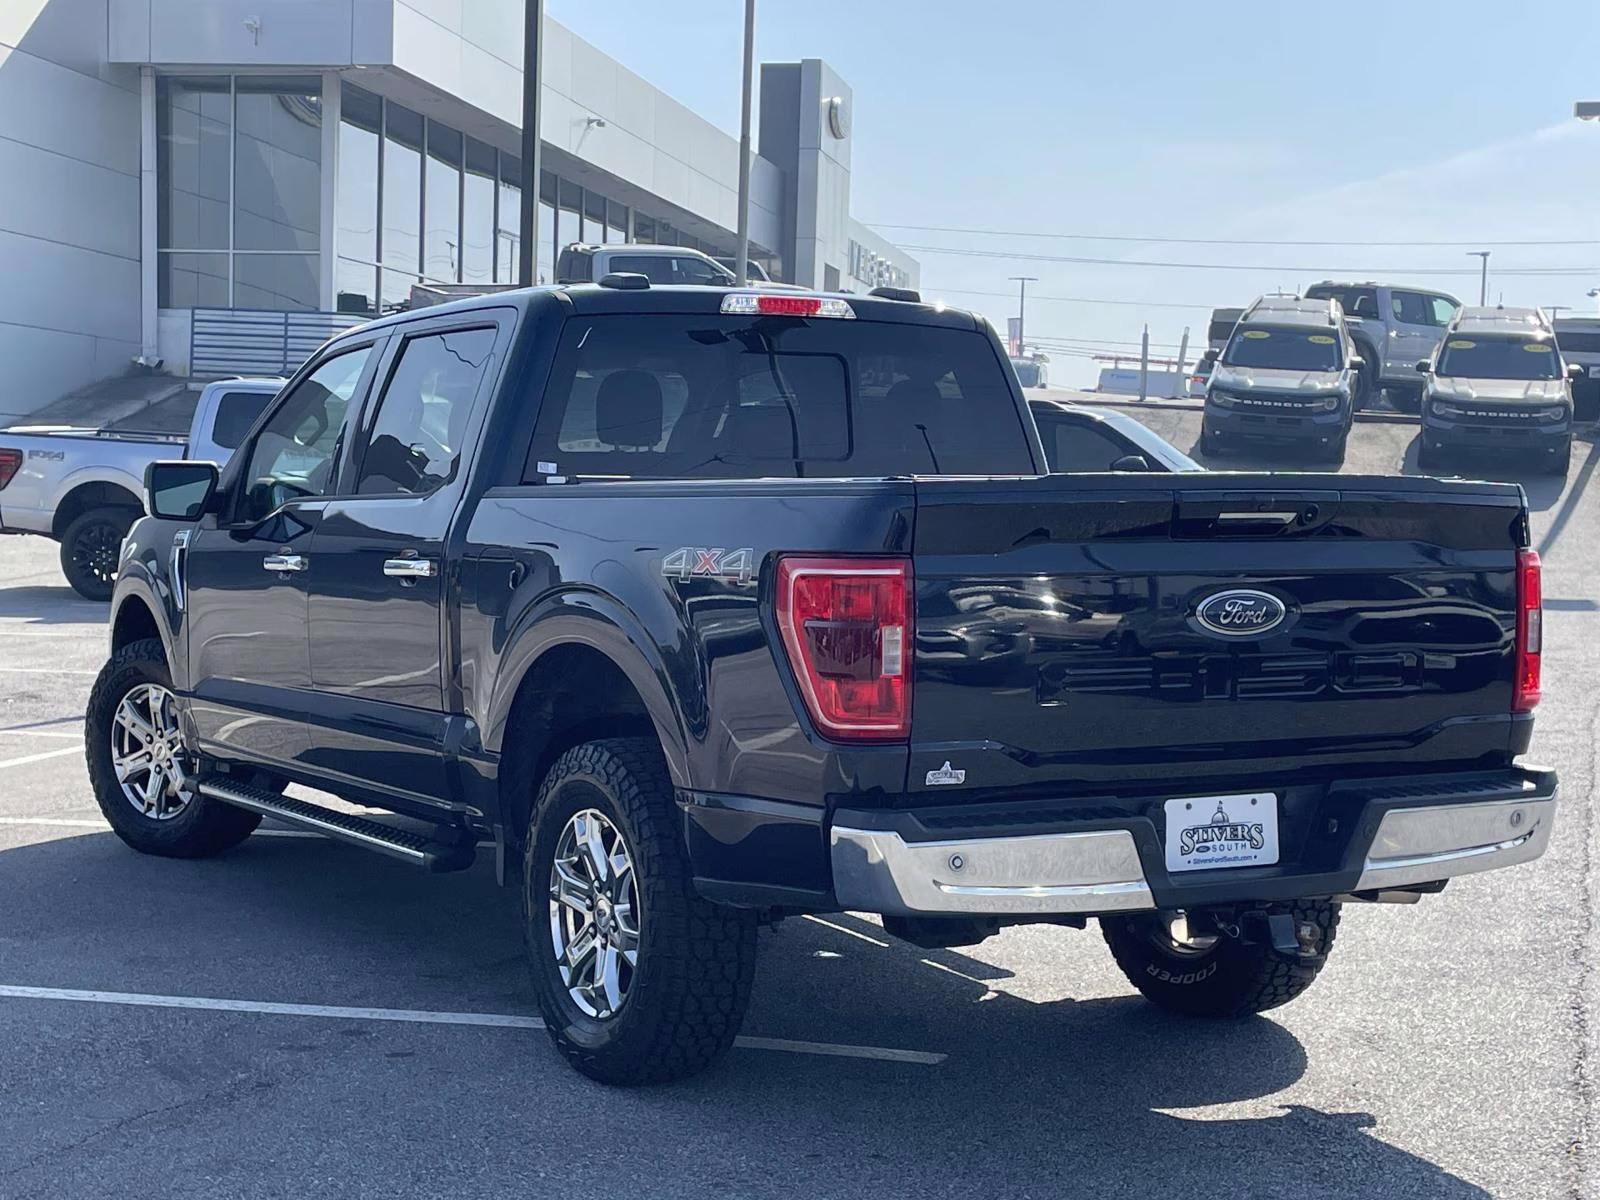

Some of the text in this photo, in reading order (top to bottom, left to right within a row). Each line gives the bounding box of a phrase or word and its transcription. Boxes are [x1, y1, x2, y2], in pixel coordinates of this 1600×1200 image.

[1243, 399, 1303, 408] BRONCO
[1466, 410, 1530, 418] BRONCO
[1219, 599, 1267, 624] Ford
[1180, 823, 1265, 856] STIVERS
[1211, 842, 1248, 853] SOUTH
[1146, 961, 1217, 985] COOPER
